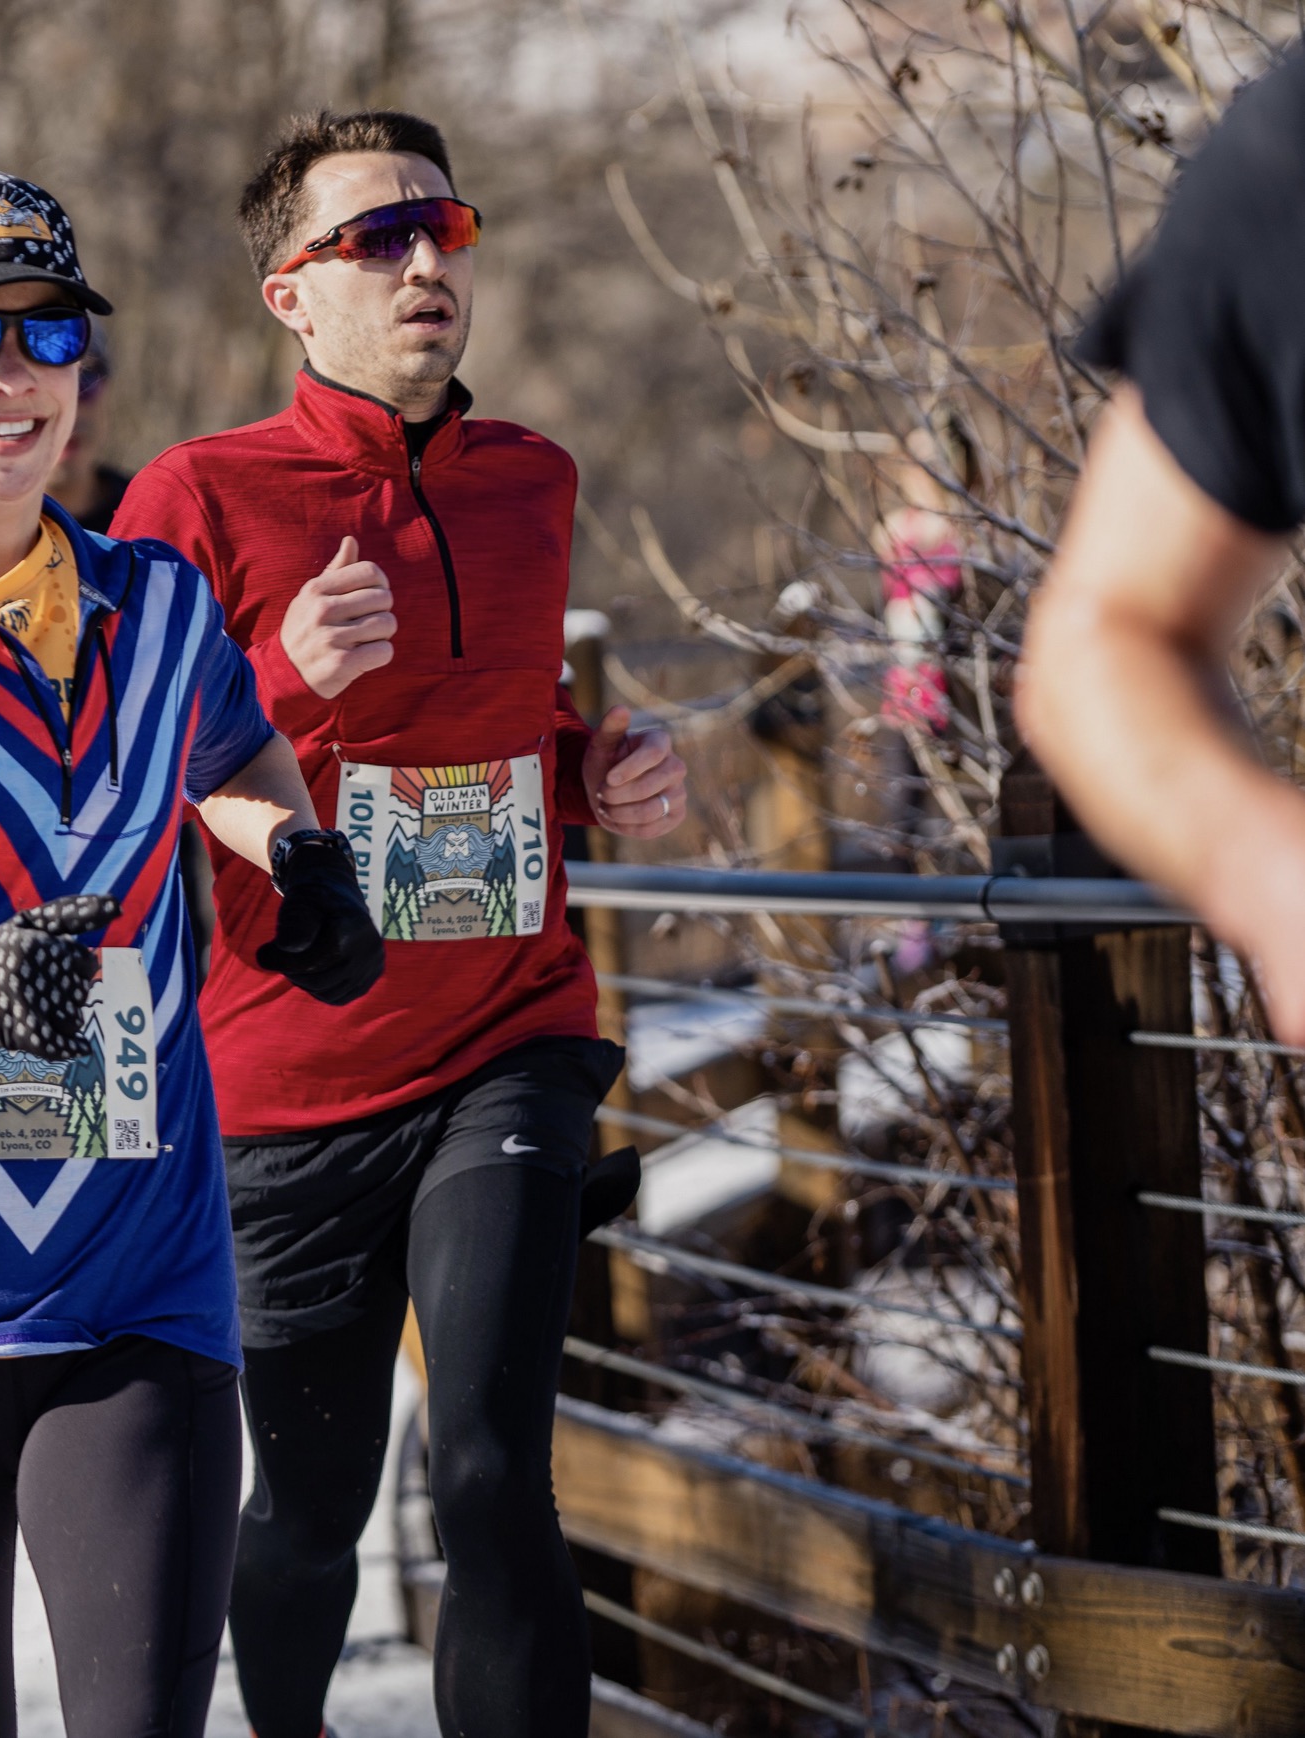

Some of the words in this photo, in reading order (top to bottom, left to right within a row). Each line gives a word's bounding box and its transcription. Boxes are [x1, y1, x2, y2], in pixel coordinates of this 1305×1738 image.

[429, 791, 455, 801] OLD
[459, 787, 486, 799] MAN
[434, 799, 482, 812] WINTER
[348, 789, 374, 843] 10K
[522, 808, 544, 880] 710
[427, 916, 445, 924] Feb.
[456, 915, 478, 923] 2024
[459, 924, 473, 933] CO
[114, 1006, 148, 1101] 949
[17, 1128, 28, 1140] 4,
[30, 1128, 58, 1138] 2024
[1, 1141, 33, 1152] Lyons,
[35, 1140, 52, 1150] CO
